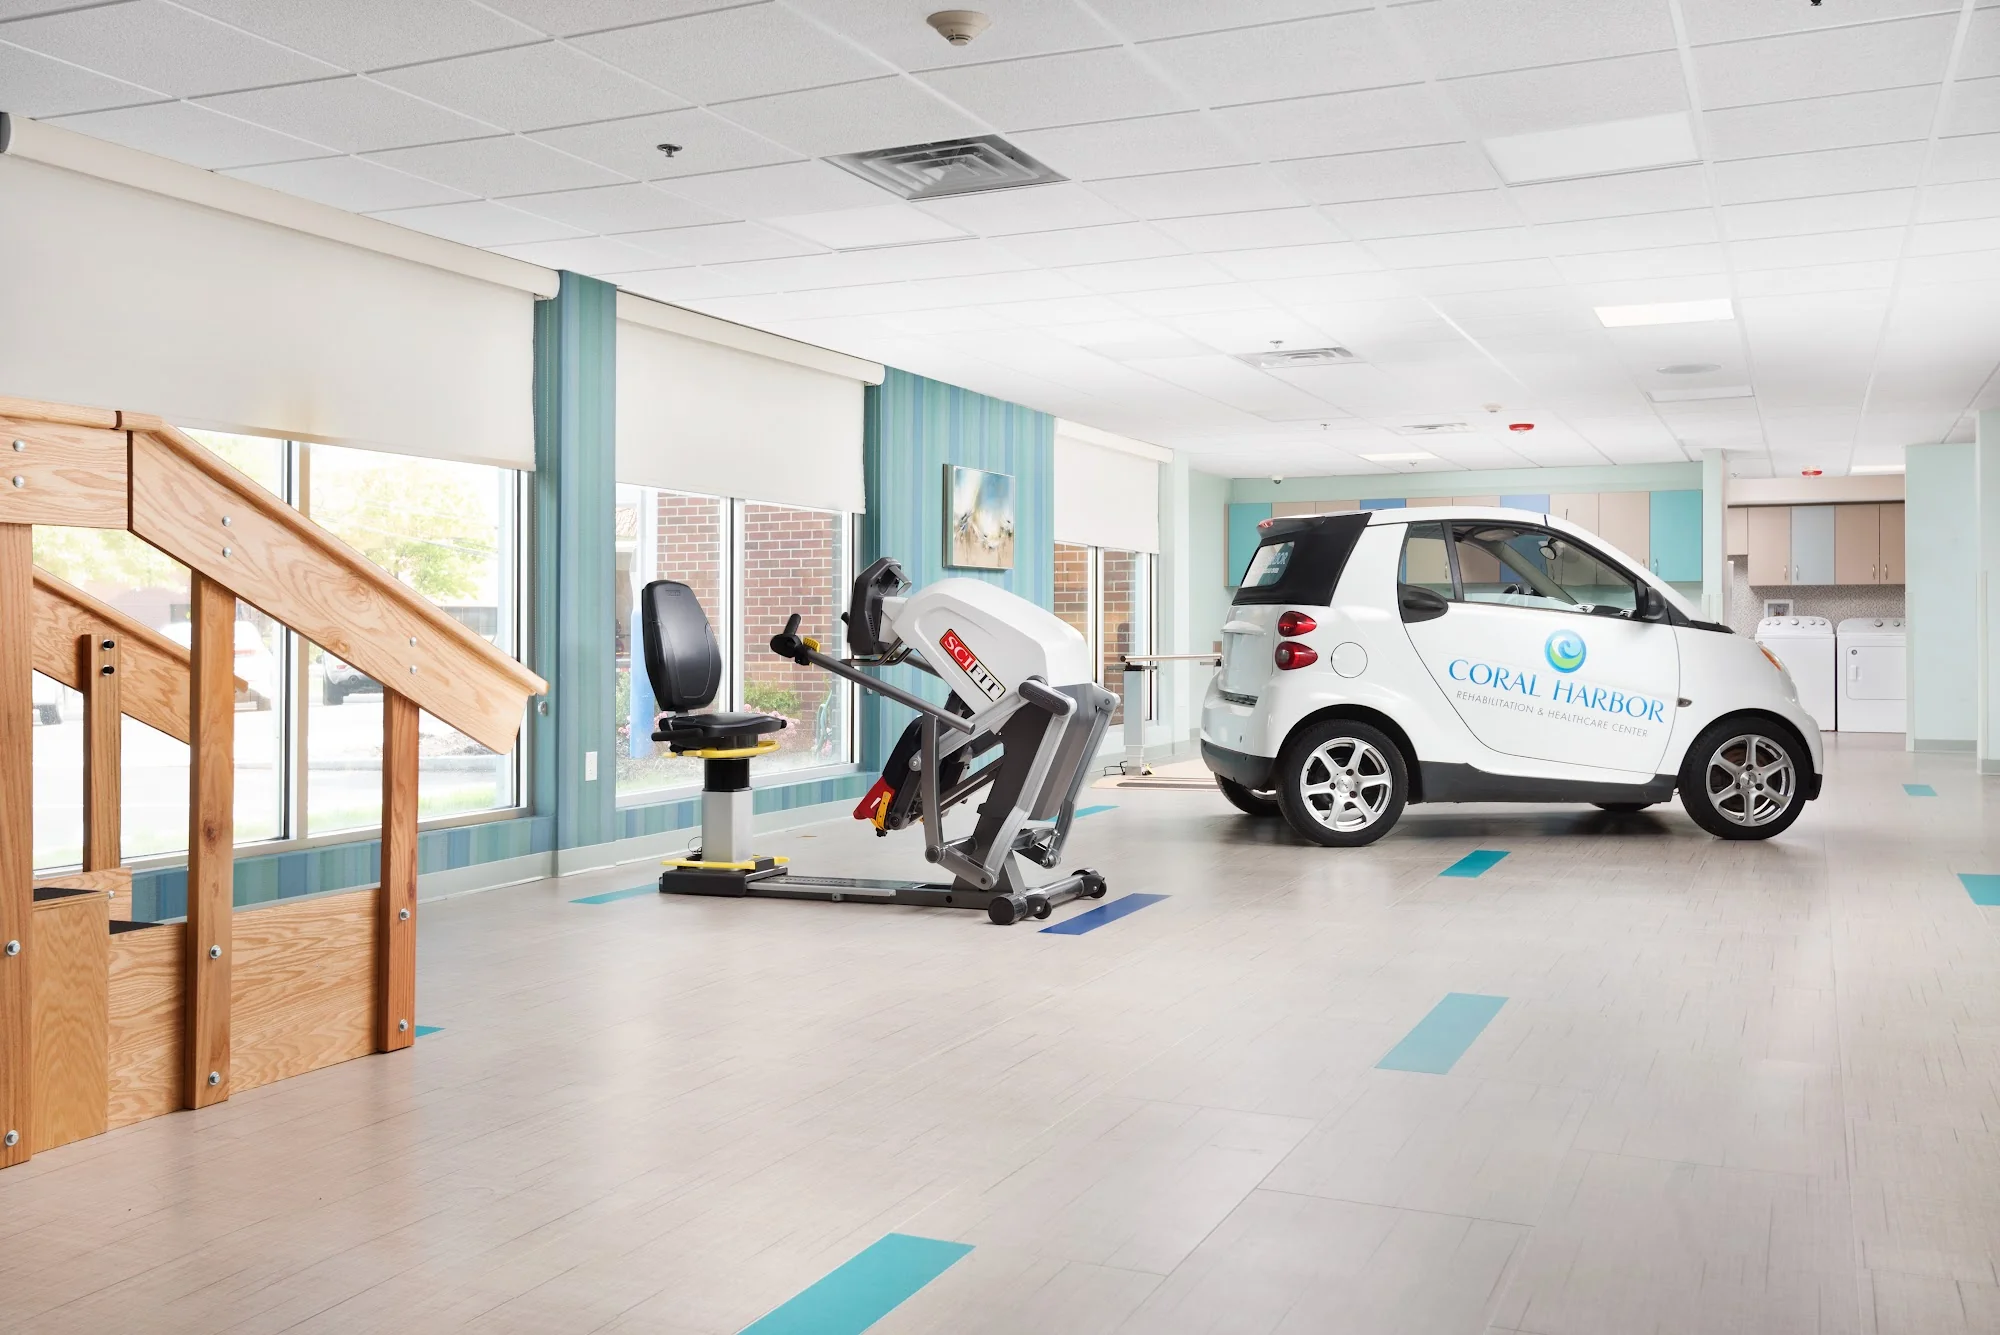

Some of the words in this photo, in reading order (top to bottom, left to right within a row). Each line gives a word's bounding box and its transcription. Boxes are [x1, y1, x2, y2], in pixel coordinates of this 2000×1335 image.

[944, 635, 1000, 693] SCIFIT
[1448, 658, 1541, 698] CORAL
[1552, 679, 1664, 724] HARBOR
[1456, 690, 1535, 714] REHABILITATION
[1537, 707, 1544, 717] &
[1547, 709, 1609, 731] HEALTHCARE
[1611, 723, 1648, 738] CENTER
